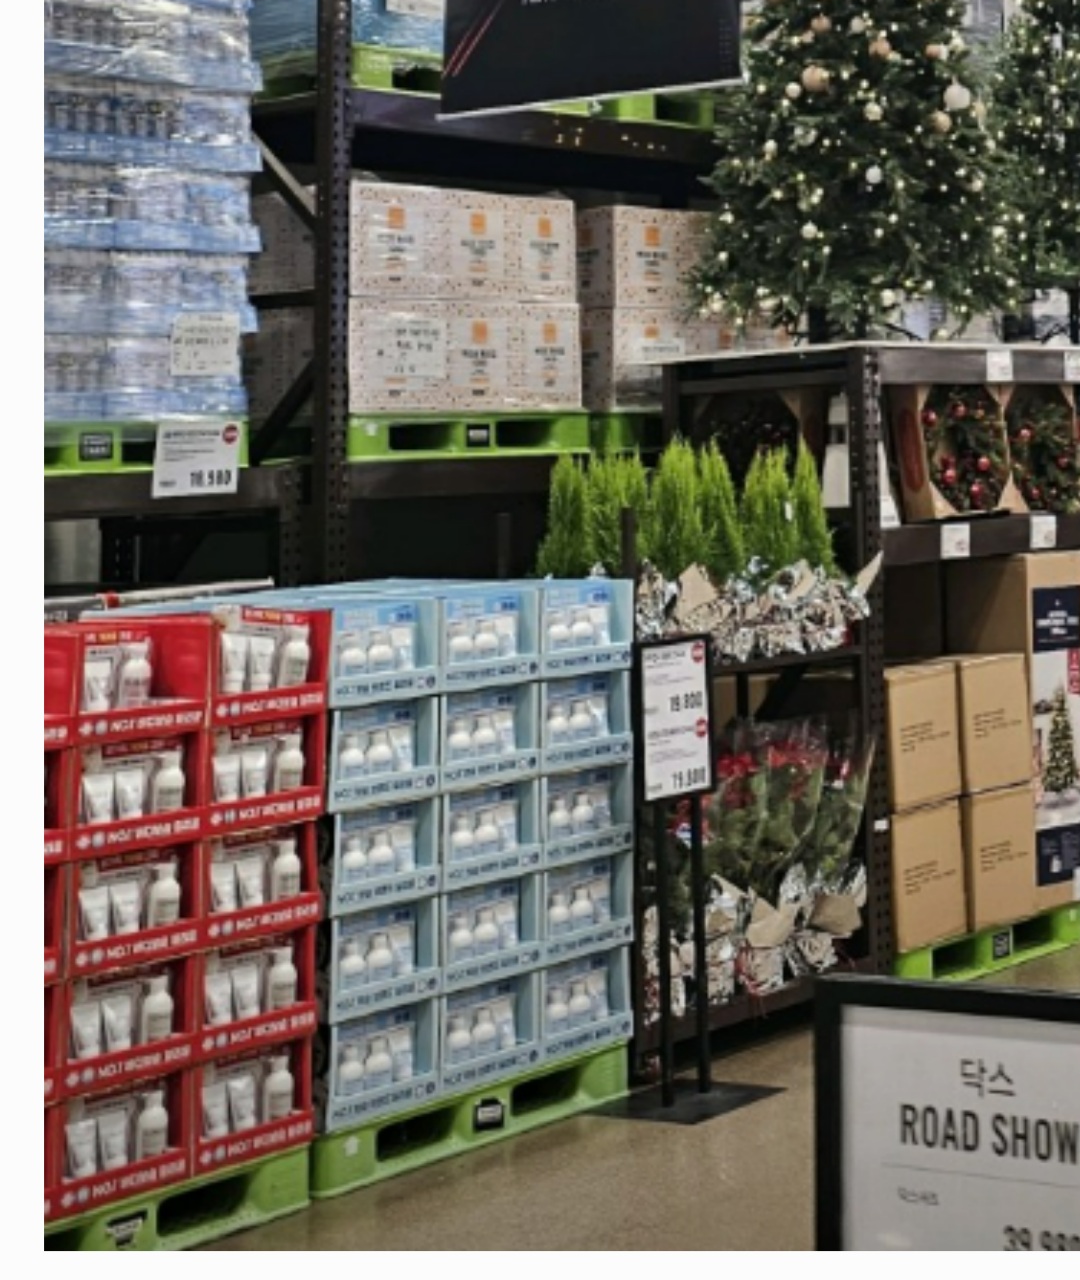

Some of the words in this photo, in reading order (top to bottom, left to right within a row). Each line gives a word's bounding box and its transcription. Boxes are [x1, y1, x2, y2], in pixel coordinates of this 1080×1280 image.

[959, 1057, 1017, 1099] 닥스
[899, 1102, 980, 1153] ROAD
[990, 1113, 1080, 1166] SHOW
